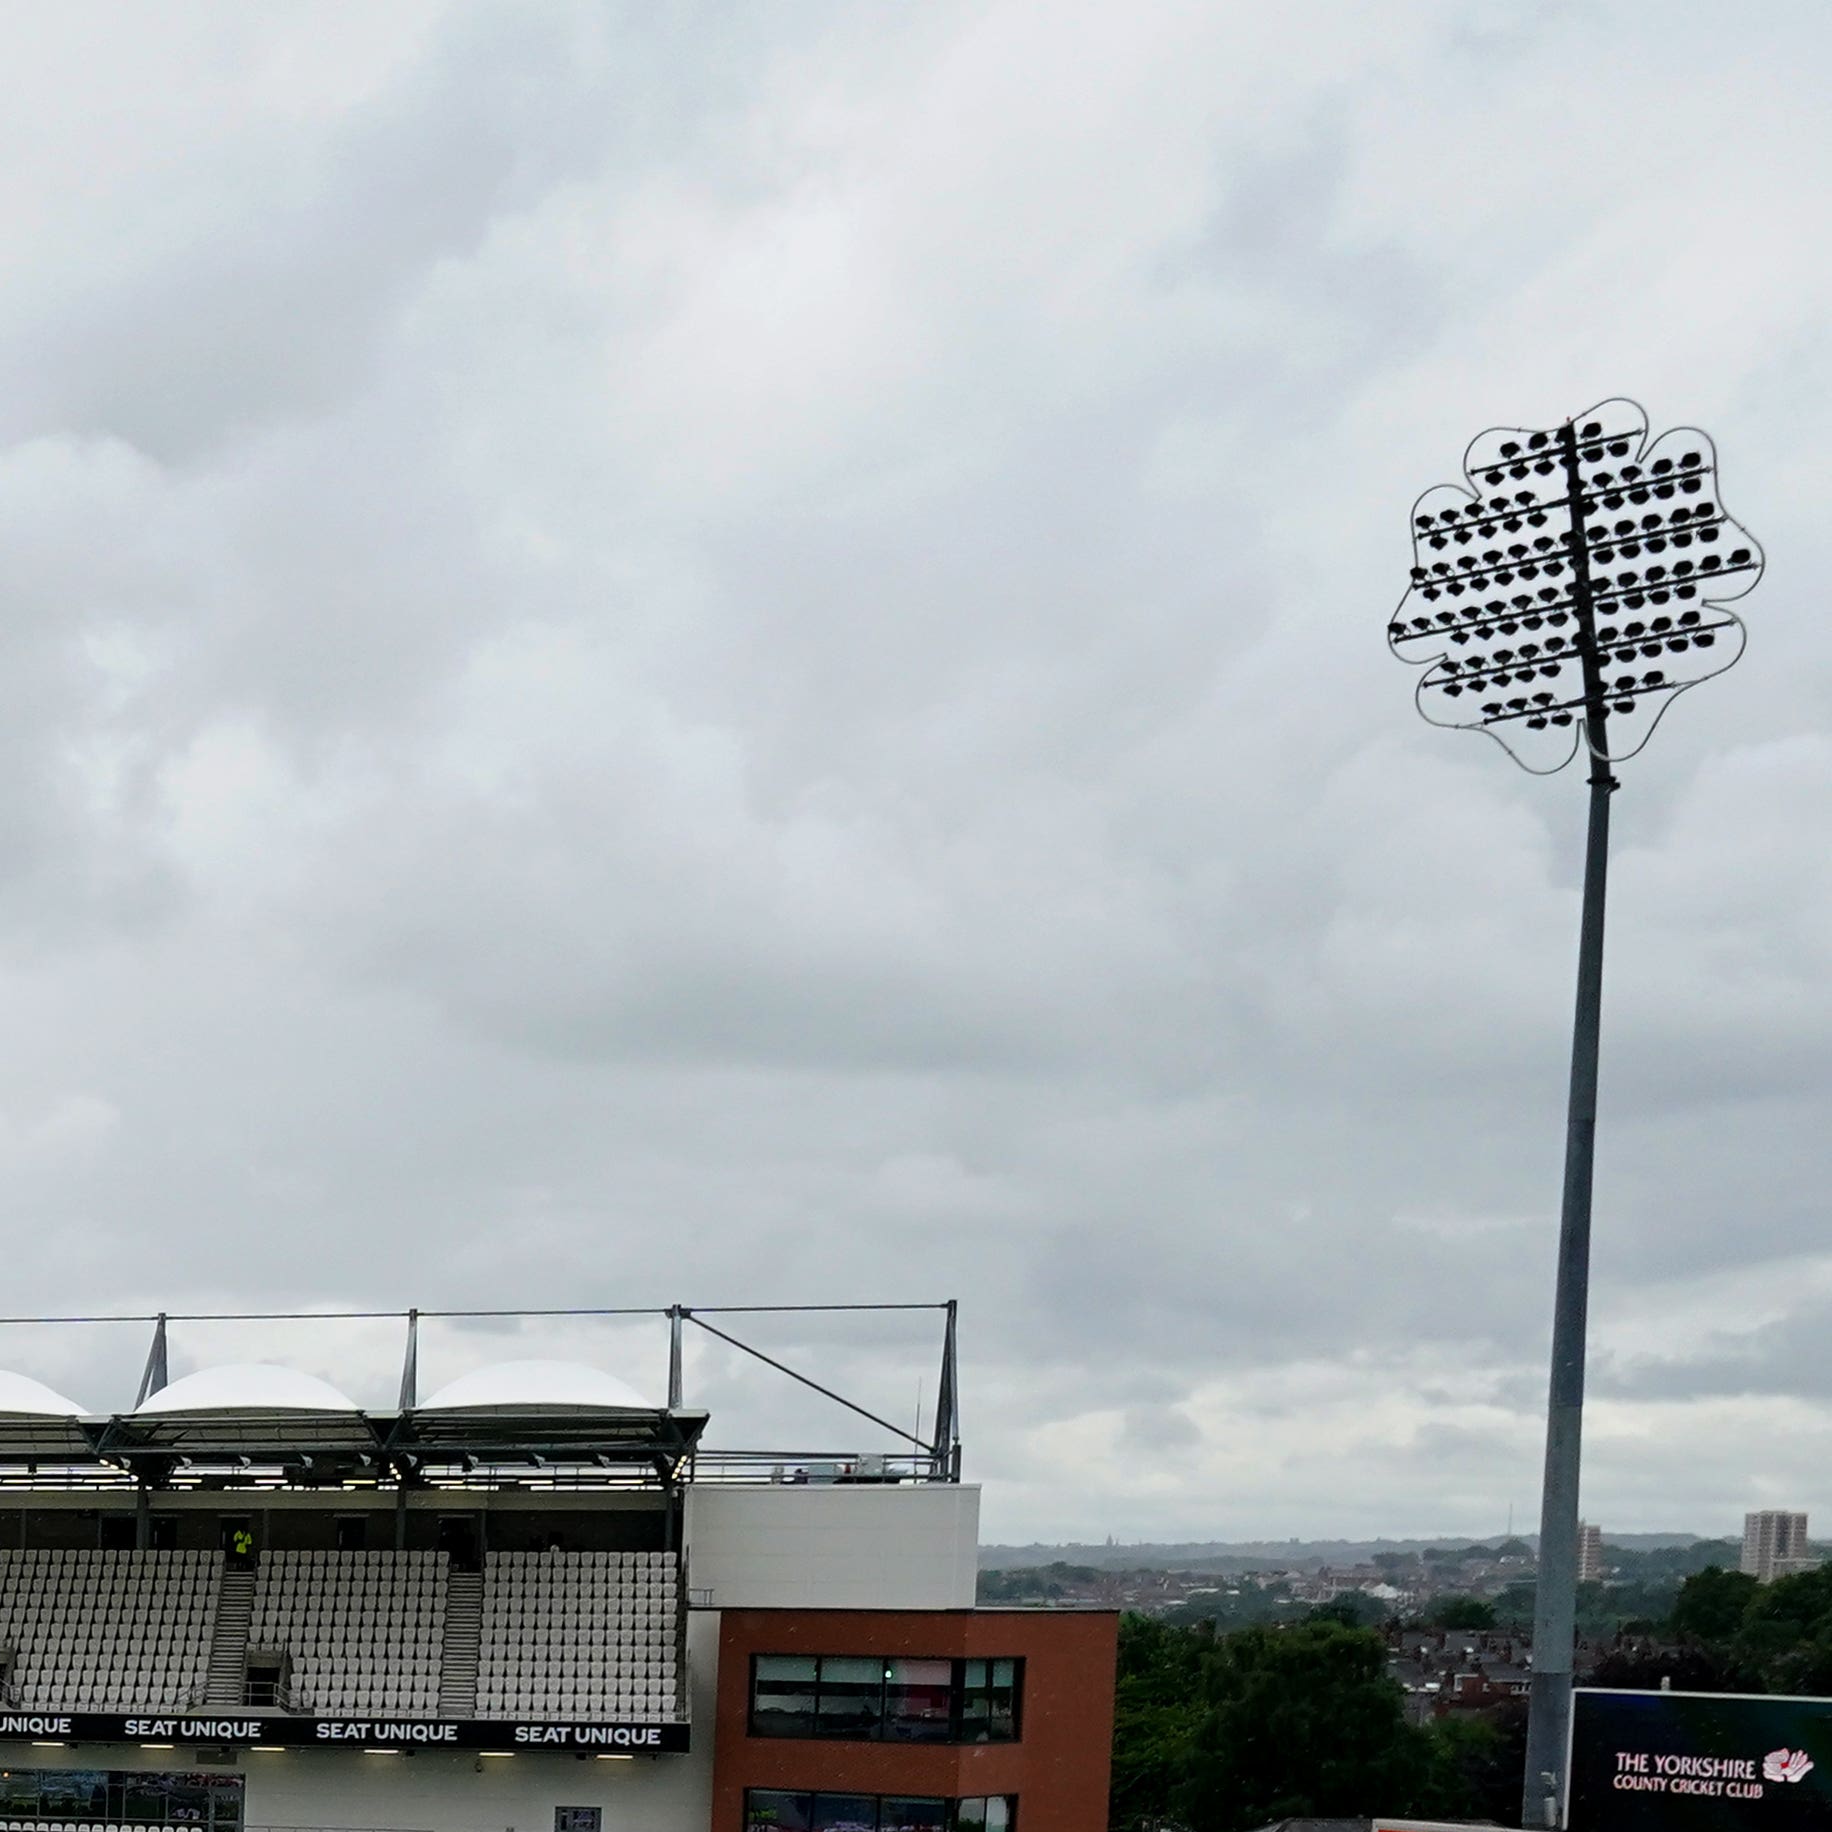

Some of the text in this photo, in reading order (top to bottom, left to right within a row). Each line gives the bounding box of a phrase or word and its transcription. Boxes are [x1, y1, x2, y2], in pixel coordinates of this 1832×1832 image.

[124, 1719, 261, 1739] SEAT UNIQUE
[515, 1726, 661, 1747] SEAT UNIQUE
[1615, 1752, 1756, 1780] THE YORKSHIRE
[1613, 1775, 1764, 1799] COUNTY CRICKET CLUB
